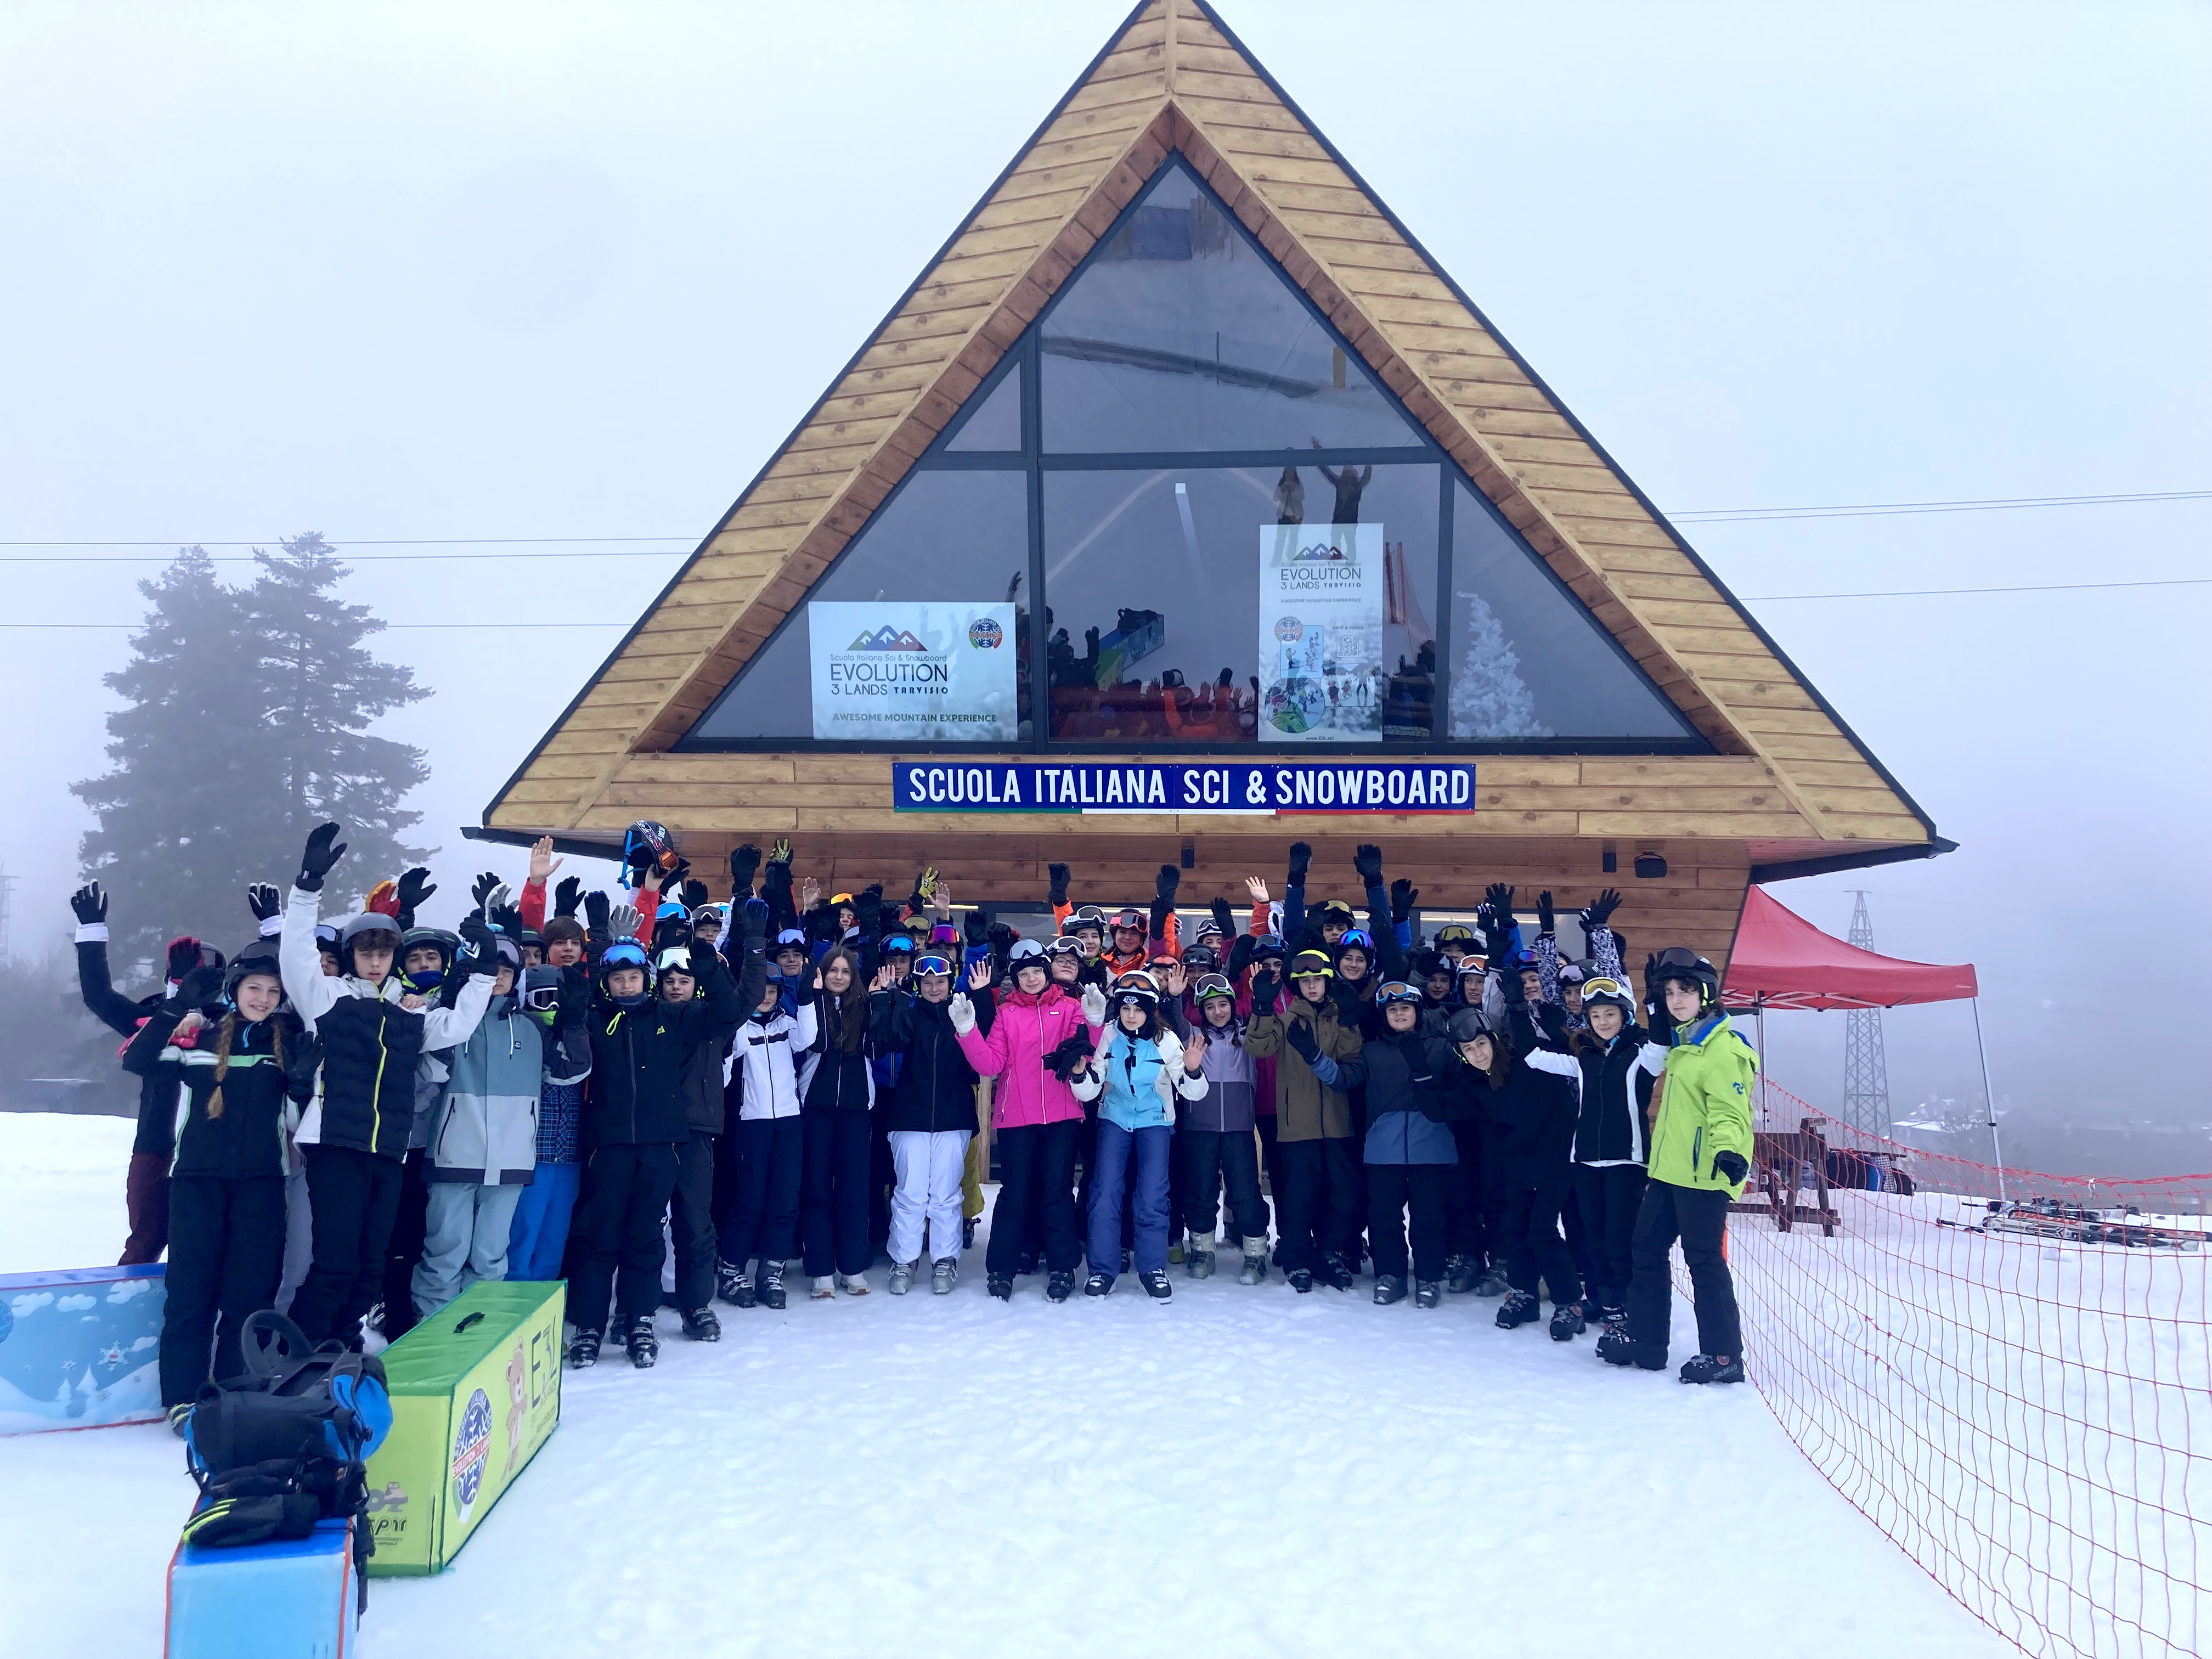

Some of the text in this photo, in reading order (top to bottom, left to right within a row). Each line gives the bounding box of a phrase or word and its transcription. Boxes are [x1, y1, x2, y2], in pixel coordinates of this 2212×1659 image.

[1281, 567, 1361, 580] EVOLUTION
[830, 663, 947, 682] EVOLUTION
[831, 684, 840, 695] 3
[845, 684, 888, 695] LANDS
[833, 713, 882, 721] AWESOME
[909, 768, 1469, 804] SCUOLA ITALIANA SCI & SNOWBOARD
[1713, 1363, 1739, 1379] DALBELLO
[453, 1451, 476, 1476] EVOLUTION
